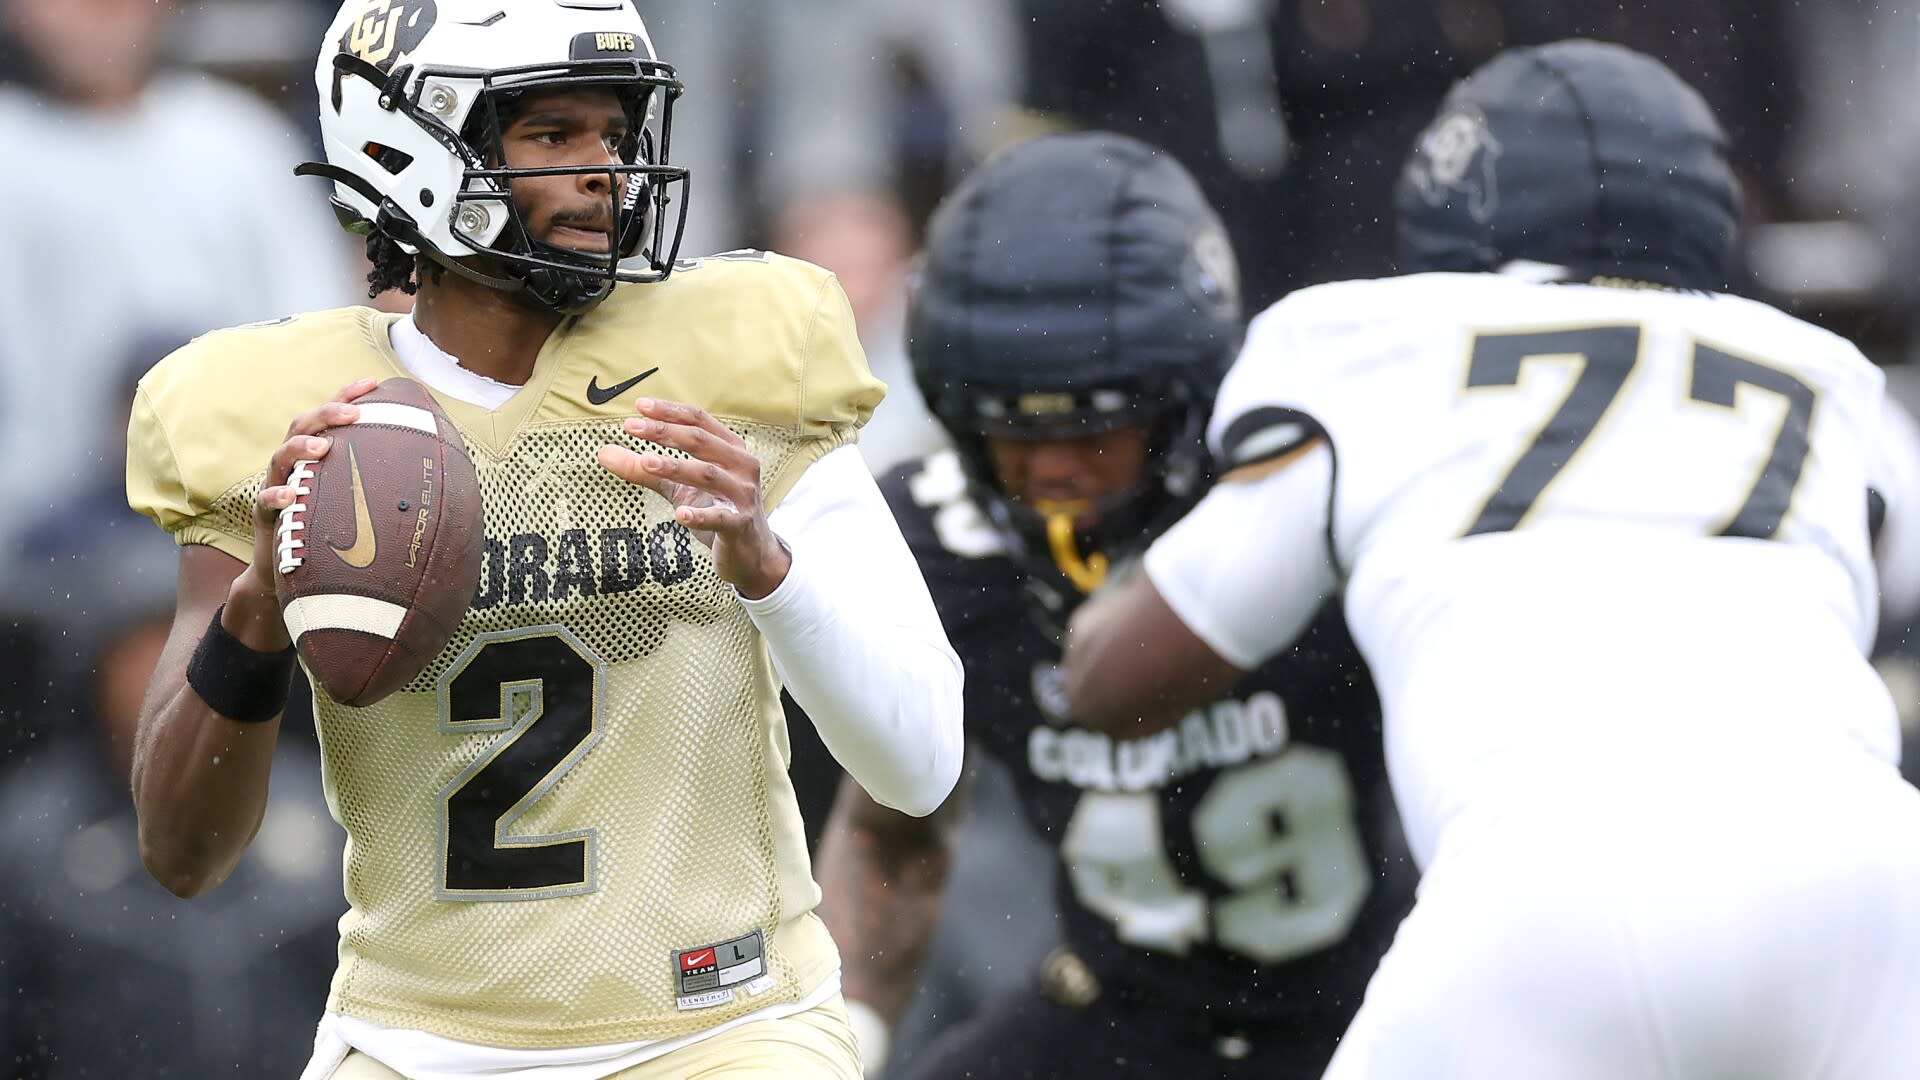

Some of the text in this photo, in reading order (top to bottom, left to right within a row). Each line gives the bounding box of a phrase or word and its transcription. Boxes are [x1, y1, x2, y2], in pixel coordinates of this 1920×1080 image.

[350, 0, 404, 66] CU
[594, 32, 635, 51] BUFFS
[622, 154, 648, 210] Riddll
[1452, 322, 1822, 542] 77
[404, 457, 433, 569] VAPOR ELITE
[470, 519, 694, 610] ORADO
[437, 625, 607, 900] 2
[1061, 744, 1372, 963] 49
[686, 965, 715, 976] TEAM
[733, 945, 745, 960] L
